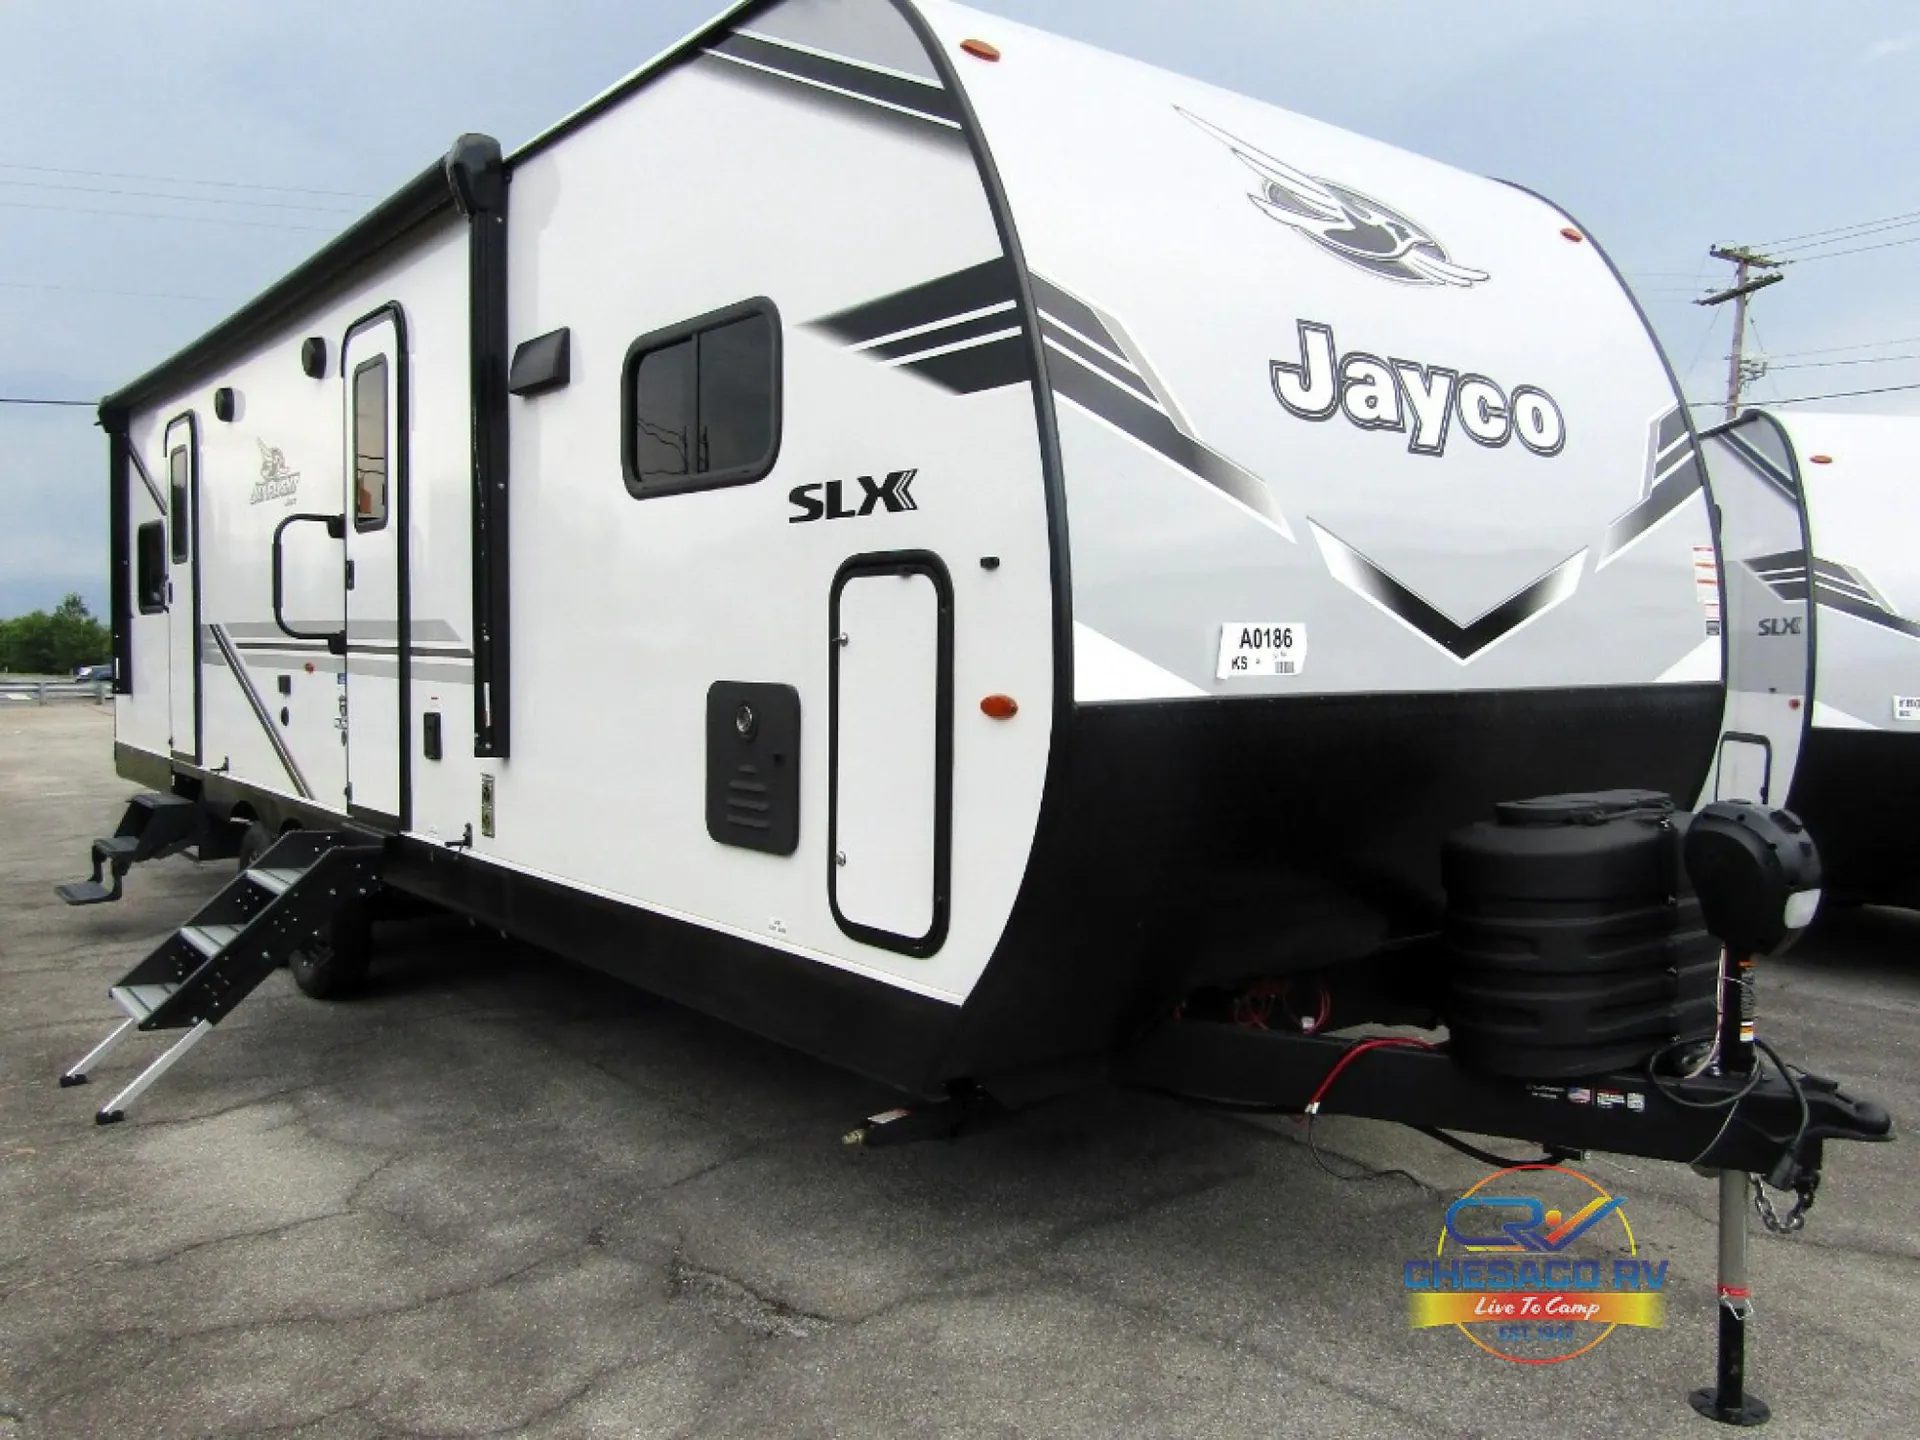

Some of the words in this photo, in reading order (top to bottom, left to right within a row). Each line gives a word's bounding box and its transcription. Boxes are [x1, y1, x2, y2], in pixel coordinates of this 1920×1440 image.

[1269, 318, 1566, 458] Jayco
[788, 467, 918, 524] SLX
[1758, 616, 1802, 637] SLX
[1239, 627, 1293, 650] A0186
[1231, 655, 1248, 671] KS
